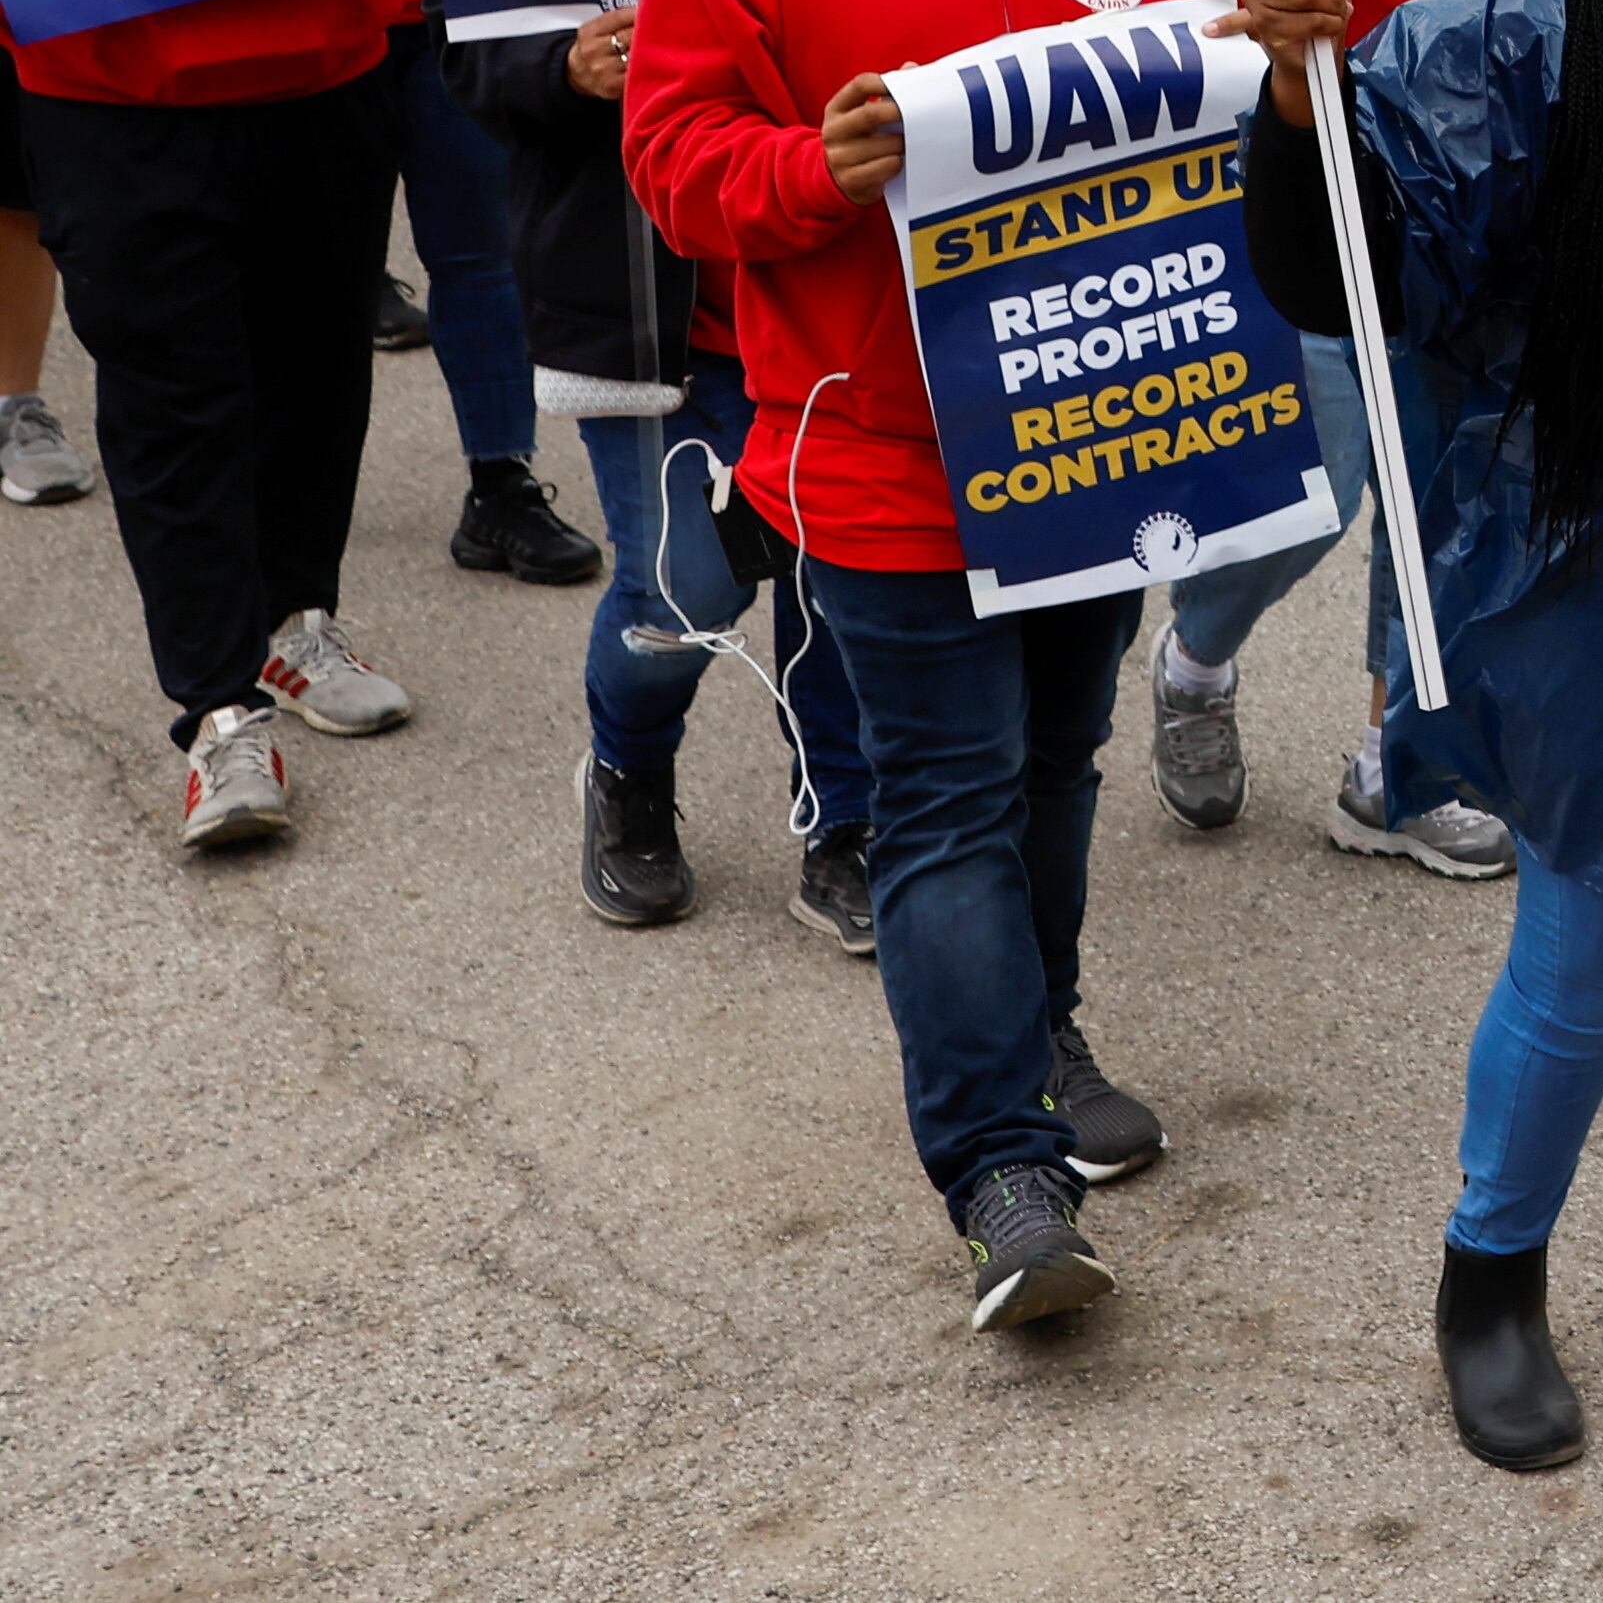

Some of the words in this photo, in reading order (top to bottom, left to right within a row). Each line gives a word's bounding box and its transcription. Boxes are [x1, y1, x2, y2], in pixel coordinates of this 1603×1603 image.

[956, 22, 1205, 175] UAW
[933, 176, 1152, 271] STAND
[988, 242, 1227, 344] RECORD
[999, 291, 1239, 396] PROFITS
[965, 383, 1301, 513] CONTRACTS
[1010, 351, 1249, 453] RECORD
